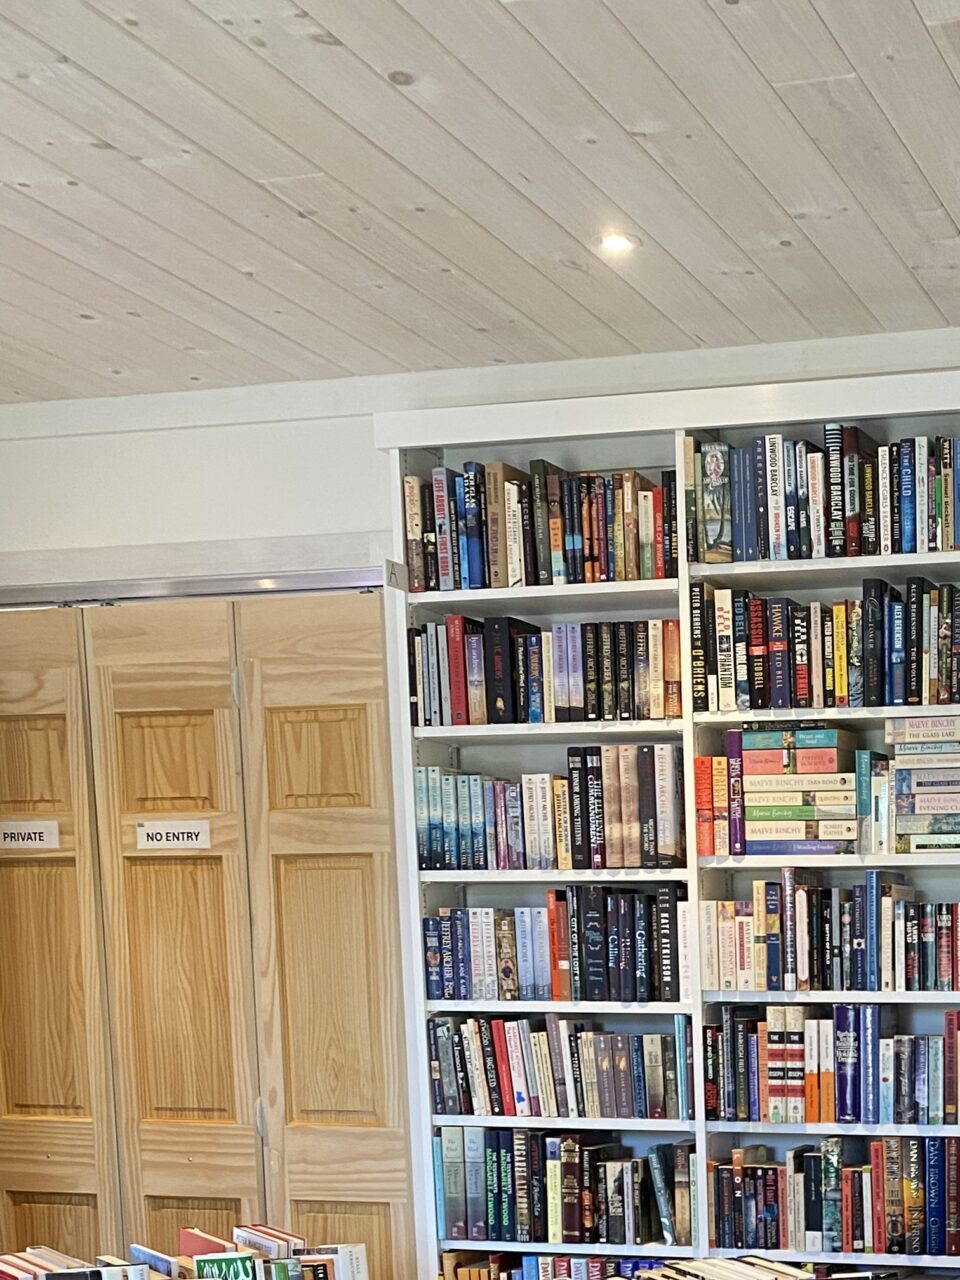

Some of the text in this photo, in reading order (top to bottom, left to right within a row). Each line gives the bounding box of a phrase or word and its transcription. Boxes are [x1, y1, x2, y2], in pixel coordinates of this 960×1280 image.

[768, 436, 779, 498] LINWOOD BARCLAY
[828, 446, 843, 523] LINWOOD BARCLAY
[901, 468, 912, 497] CHILD
[463, 472, 471, 506] ADAMS
[468, 471, 478, 509] DOUGLAS
[771, 603, 783, 639] HAWKE
[692, 649, 706, 698] O'BRIENS
[719, 652, 733, 689] PHANTOM
[736, 641, 748, 681] WARLORD
[908, 719, 956, 729] MAEVE BINCHY
[587, 775, 597, 848] COMMANDMENT
[3, 832, 44, 842] PRIVATE
[146, 832, 200, 842] NO ENTRY
[635, 929, 647, 979] Gathering
[659, 913, 672, 982] KATE ATKINSON
[909, 1141, 920, 1161] DAN
[734, 1153, 744, 1198] LION
[929, 1141, 938, 1209] DAN BROWN
[907, 1203, 921, 1253] INFERNO
